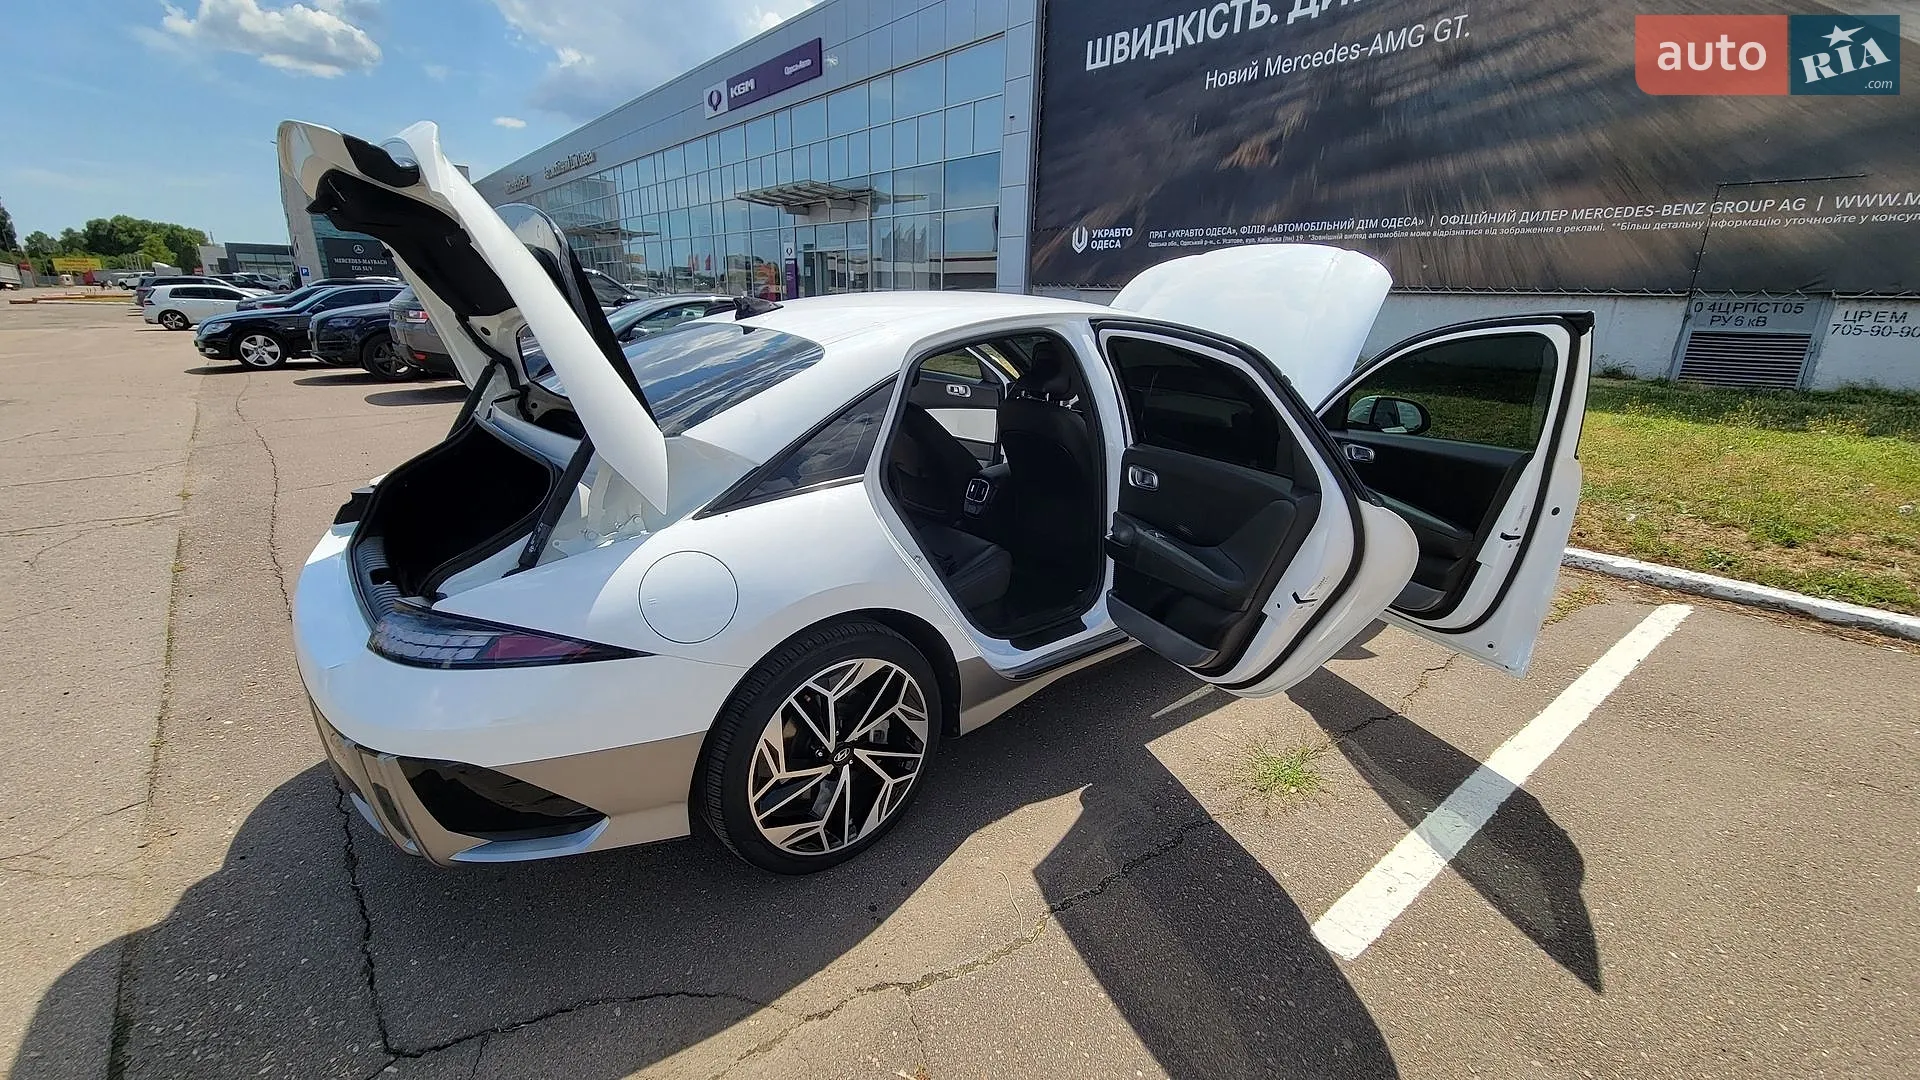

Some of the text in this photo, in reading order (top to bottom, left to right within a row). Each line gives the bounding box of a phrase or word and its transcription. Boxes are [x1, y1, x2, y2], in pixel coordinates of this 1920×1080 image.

[1086, 0, 1279, 71] ШВИДКІСТЬ.
[1205, 15, 1470, 90] Новий Mercedes-AMG GT.
[730, 78, 755, 98] KGM
[1149, 231, 1167, 239] ПРАТ
[1168, 228, 1204, 238] «УКРАВТО
[1205, 227, 1238, 237] ОДЕСА»,
[1240, 225, 1266, 234] ФІЛІЯ
[1268, 218, 1355, 233] «АВТОМОБІЛЬНИЙ
[1356, 219, 1379, 231] ДІМ
[1381, 215, 1424, 230] ОДЕСА»
[1440, 209, 1517, 226] ОФІЦІЙНИЙ
[1518, 209, 1569, 224] ДИЛЕР
[1571, 202, 1707, 220] MERCEDES-BENZ
[1710, 199, 1776, 214] GROUP
[1778, 197, 1807, 212] AG
[1368, 230, 1409, 239] автомобіля
[1432, 228, 1483, 238] відрізнятися
[1484, 227, 1498, 236] від
[1499, 225, 1554, 236] зображення
[1563, 223, 1605, 234] рекламі.
[1652, 221, 1705, 230] детальну
[1706, 216, 1781, 229] інформацію
[1784, 213, 1857, 227] уточнюйте
[1858, 214, 1869, 225] у
[1091, 227, 1133, 239] УКРАВТО
[1090, 239, 1122, 251] ОДЕСА
[1843, 310, 1908, 324] ЦРЕМ
[1831, 323, 1920, 338] 705-90-90
